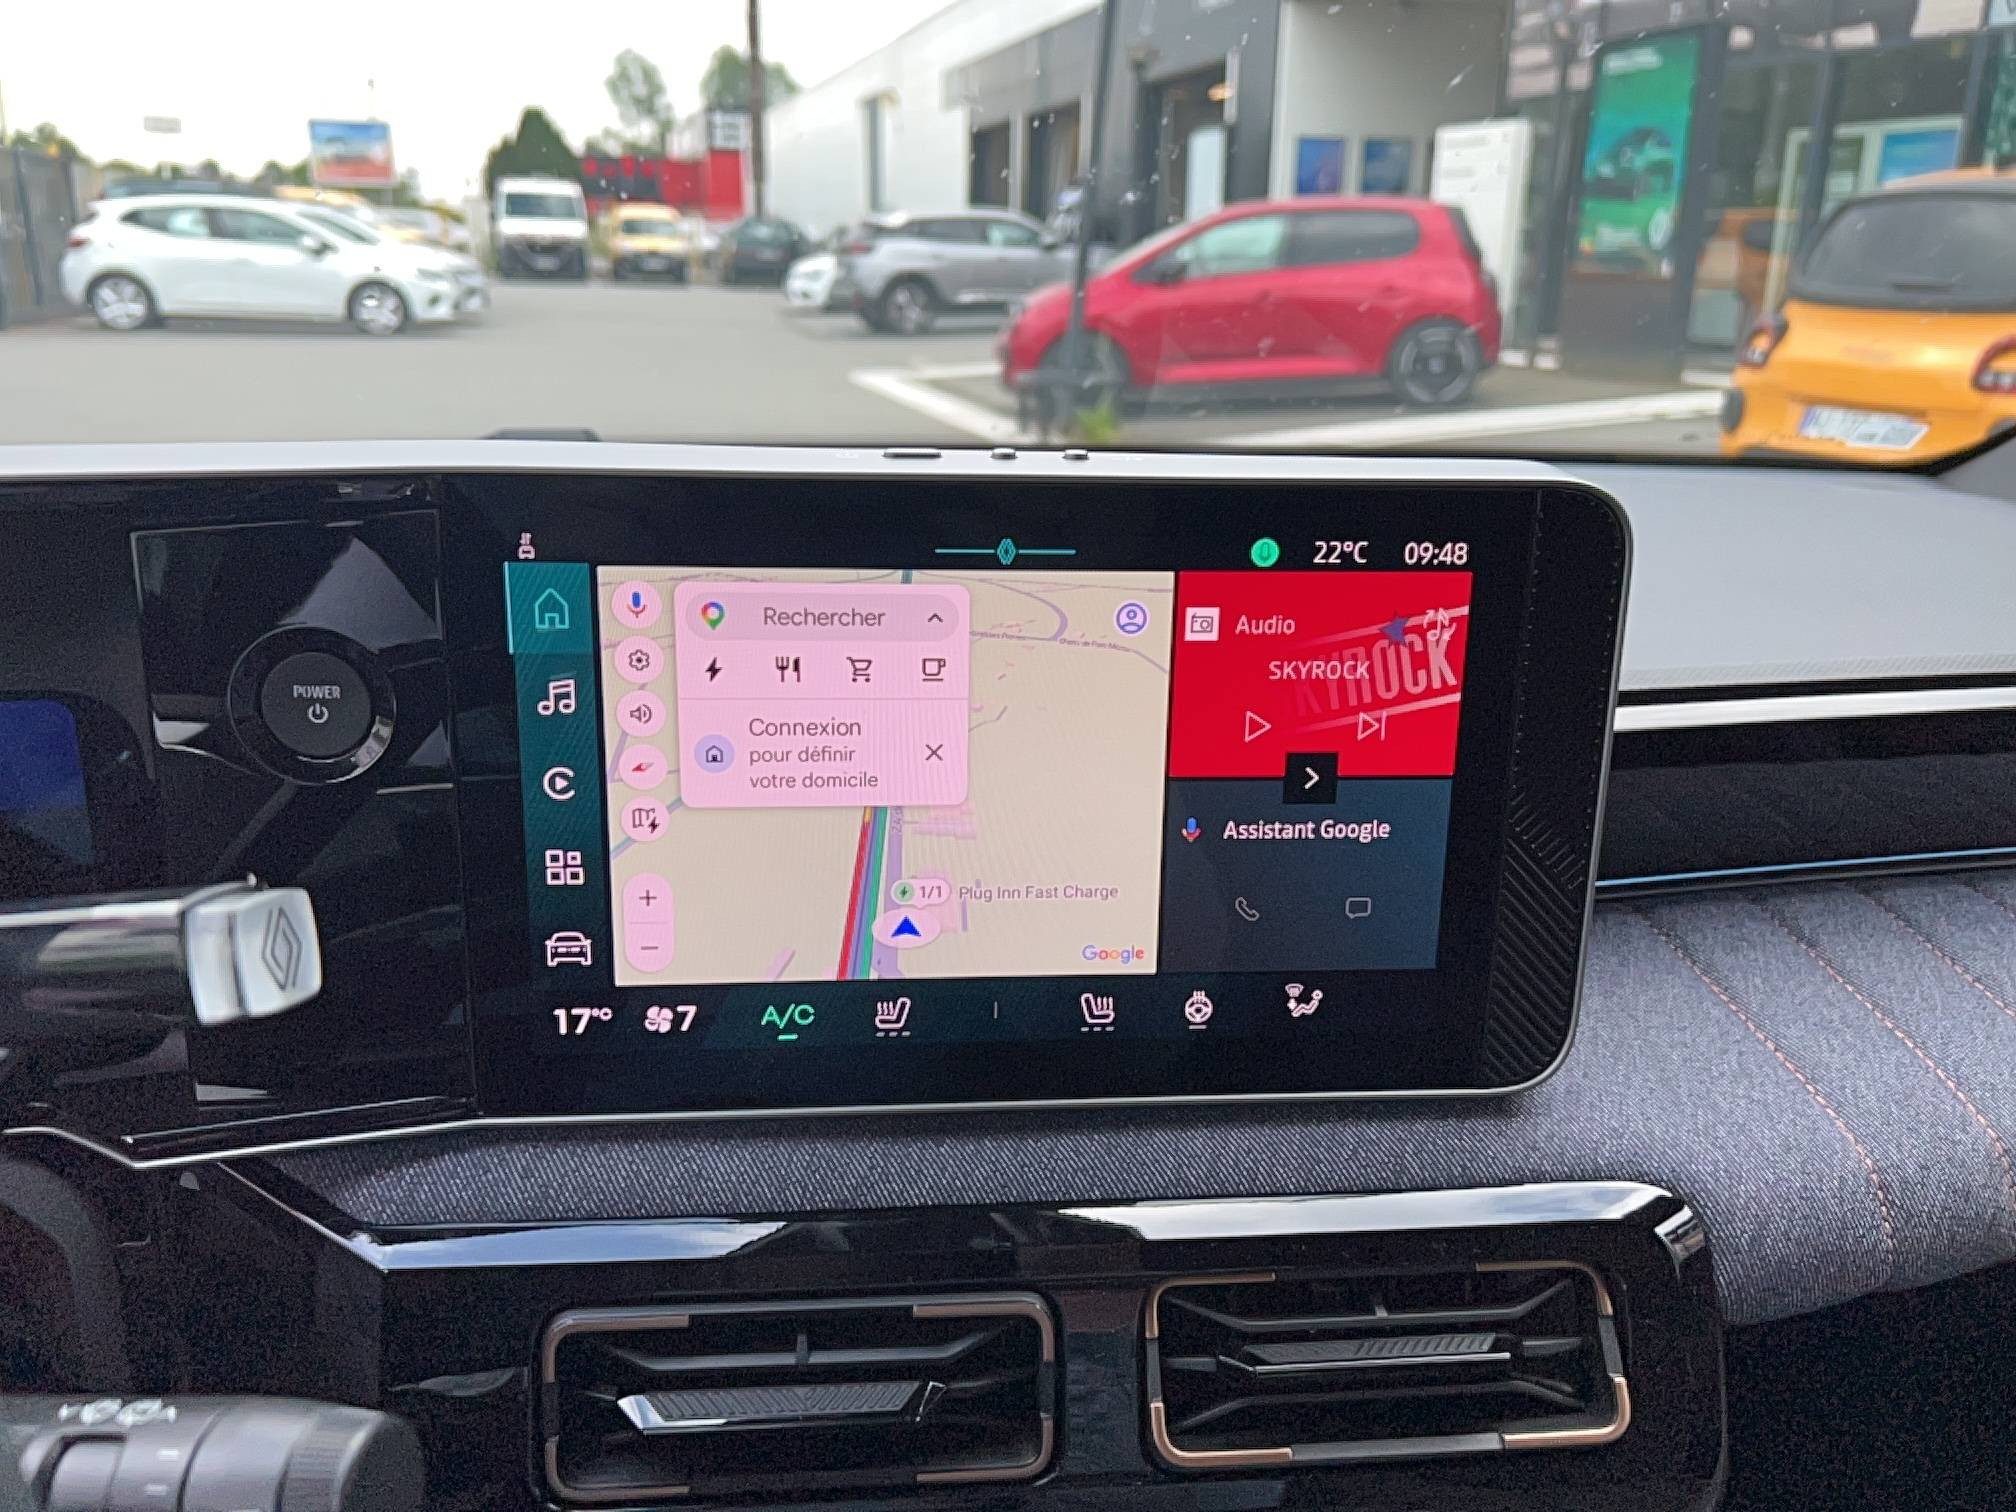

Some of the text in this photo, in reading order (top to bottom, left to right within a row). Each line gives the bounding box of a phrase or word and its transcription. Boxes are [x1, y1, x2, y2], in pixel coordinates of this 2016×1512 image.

[1312, 540, 1369, 564] 22°C
[1404, 541, 1469, 565] 09:48
[763, 606, 886, 627] Rechercher
[1235, 614, 1296, 635] Audio
[1268, 660, 1370, 681] SKYROCK
[292, 684, 341, 699] POWER
[749, 717, 862, 737] Connexion
[749, 745, 856, 766] pour définir
[749, 771, 879, 788] votre domicile
[1222, 819, 1392, 843] Assistant Google
[920, 885, 1119, 902] 1/1 Plug Inn Fast Charge
[1081, 944, 1145, 964] Google
[675, 1004, 698, 1032] 7
[760, 1002, 816, 1030] A/C
